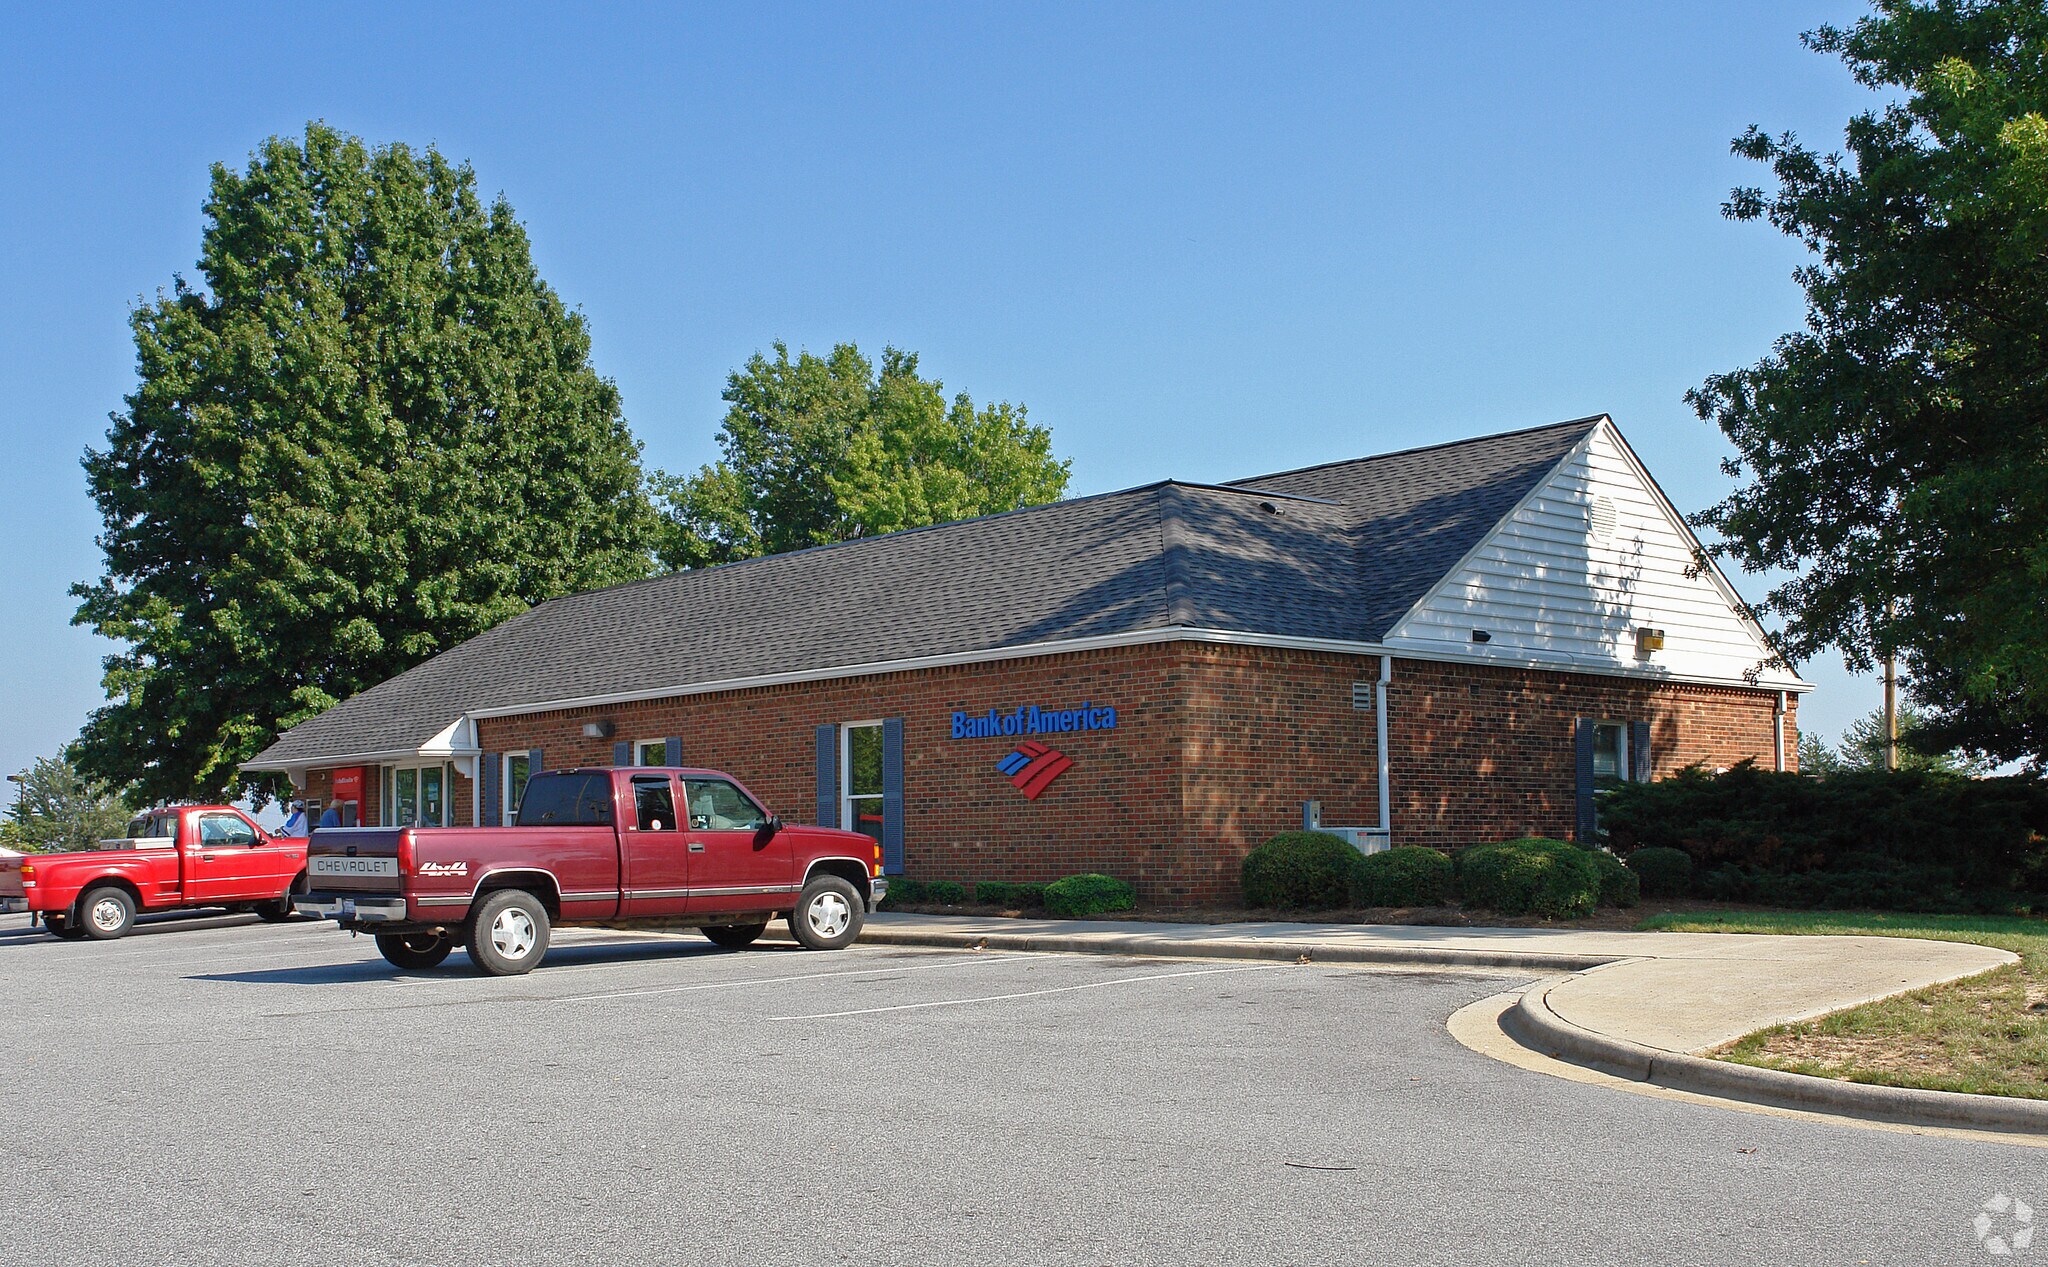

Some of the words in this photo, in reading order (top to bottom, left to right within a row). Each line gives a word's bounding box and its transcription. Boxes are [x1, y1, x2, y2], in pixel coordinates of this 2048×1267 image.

[951, 708, 1002, 739] Bank
[1003, 706, 1025, 736] of
[1027, 701, 1117, 734] America
[317, 860, 389, 873] CHEVROLET
[419, 861, 468, 876] 4x4
